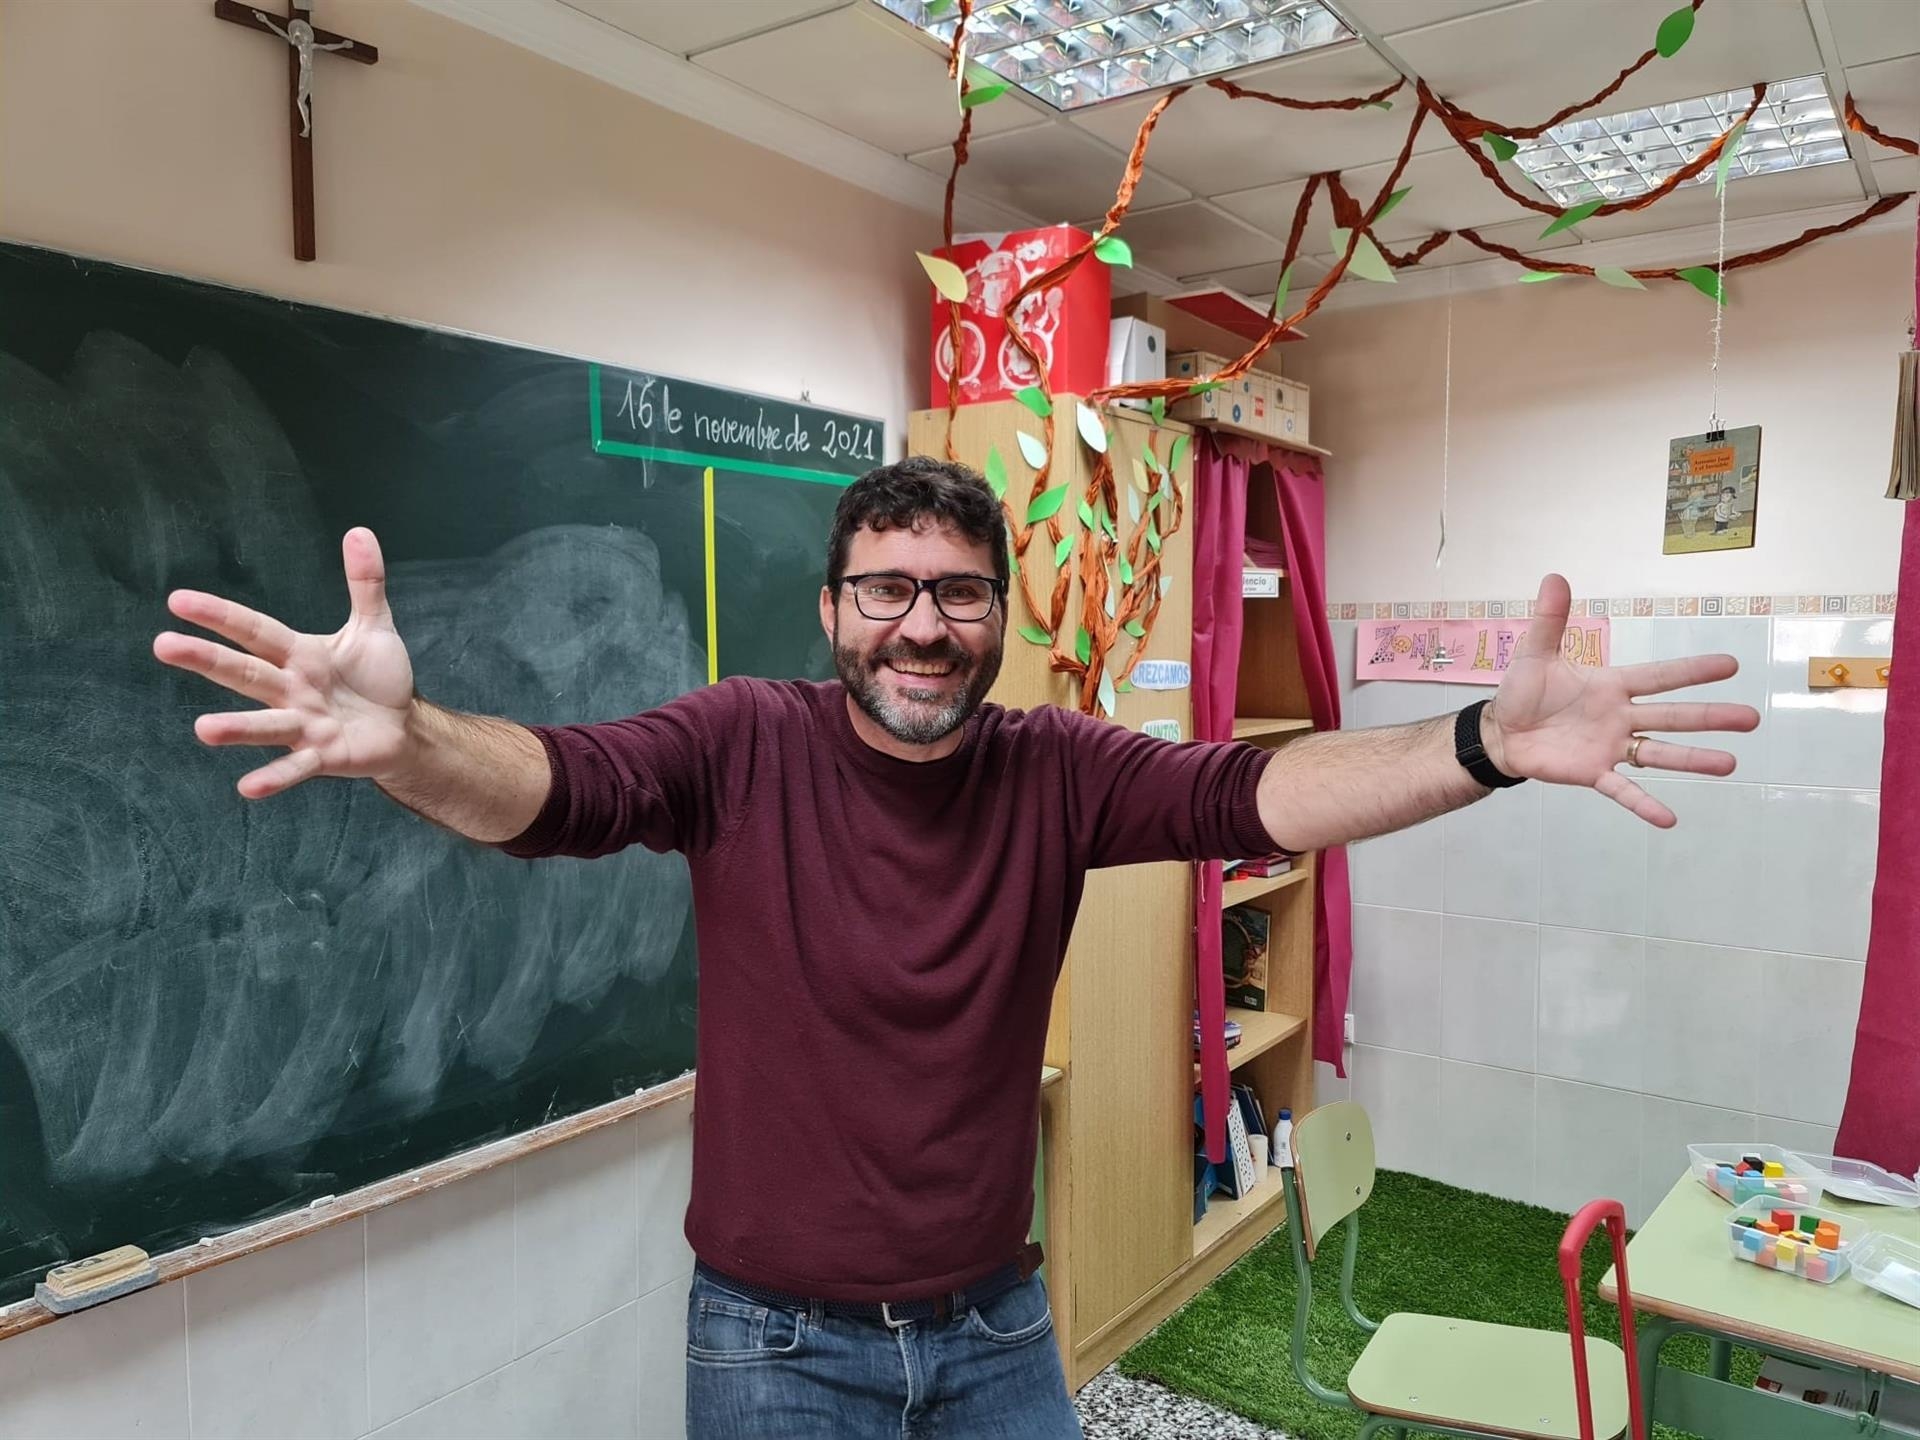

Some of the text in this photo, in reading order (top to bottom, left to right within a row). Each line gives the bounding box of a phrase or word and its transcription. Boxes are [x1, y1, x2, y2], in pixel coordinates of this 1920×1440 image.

[616, 379, 656, 430] 16
[694, 407, 783, 451] novembre
[785, 413, 810, 452] de
[821, 420, 875, 460] 2021
[1132, 663, 1189, 684] CREZCAMOS
